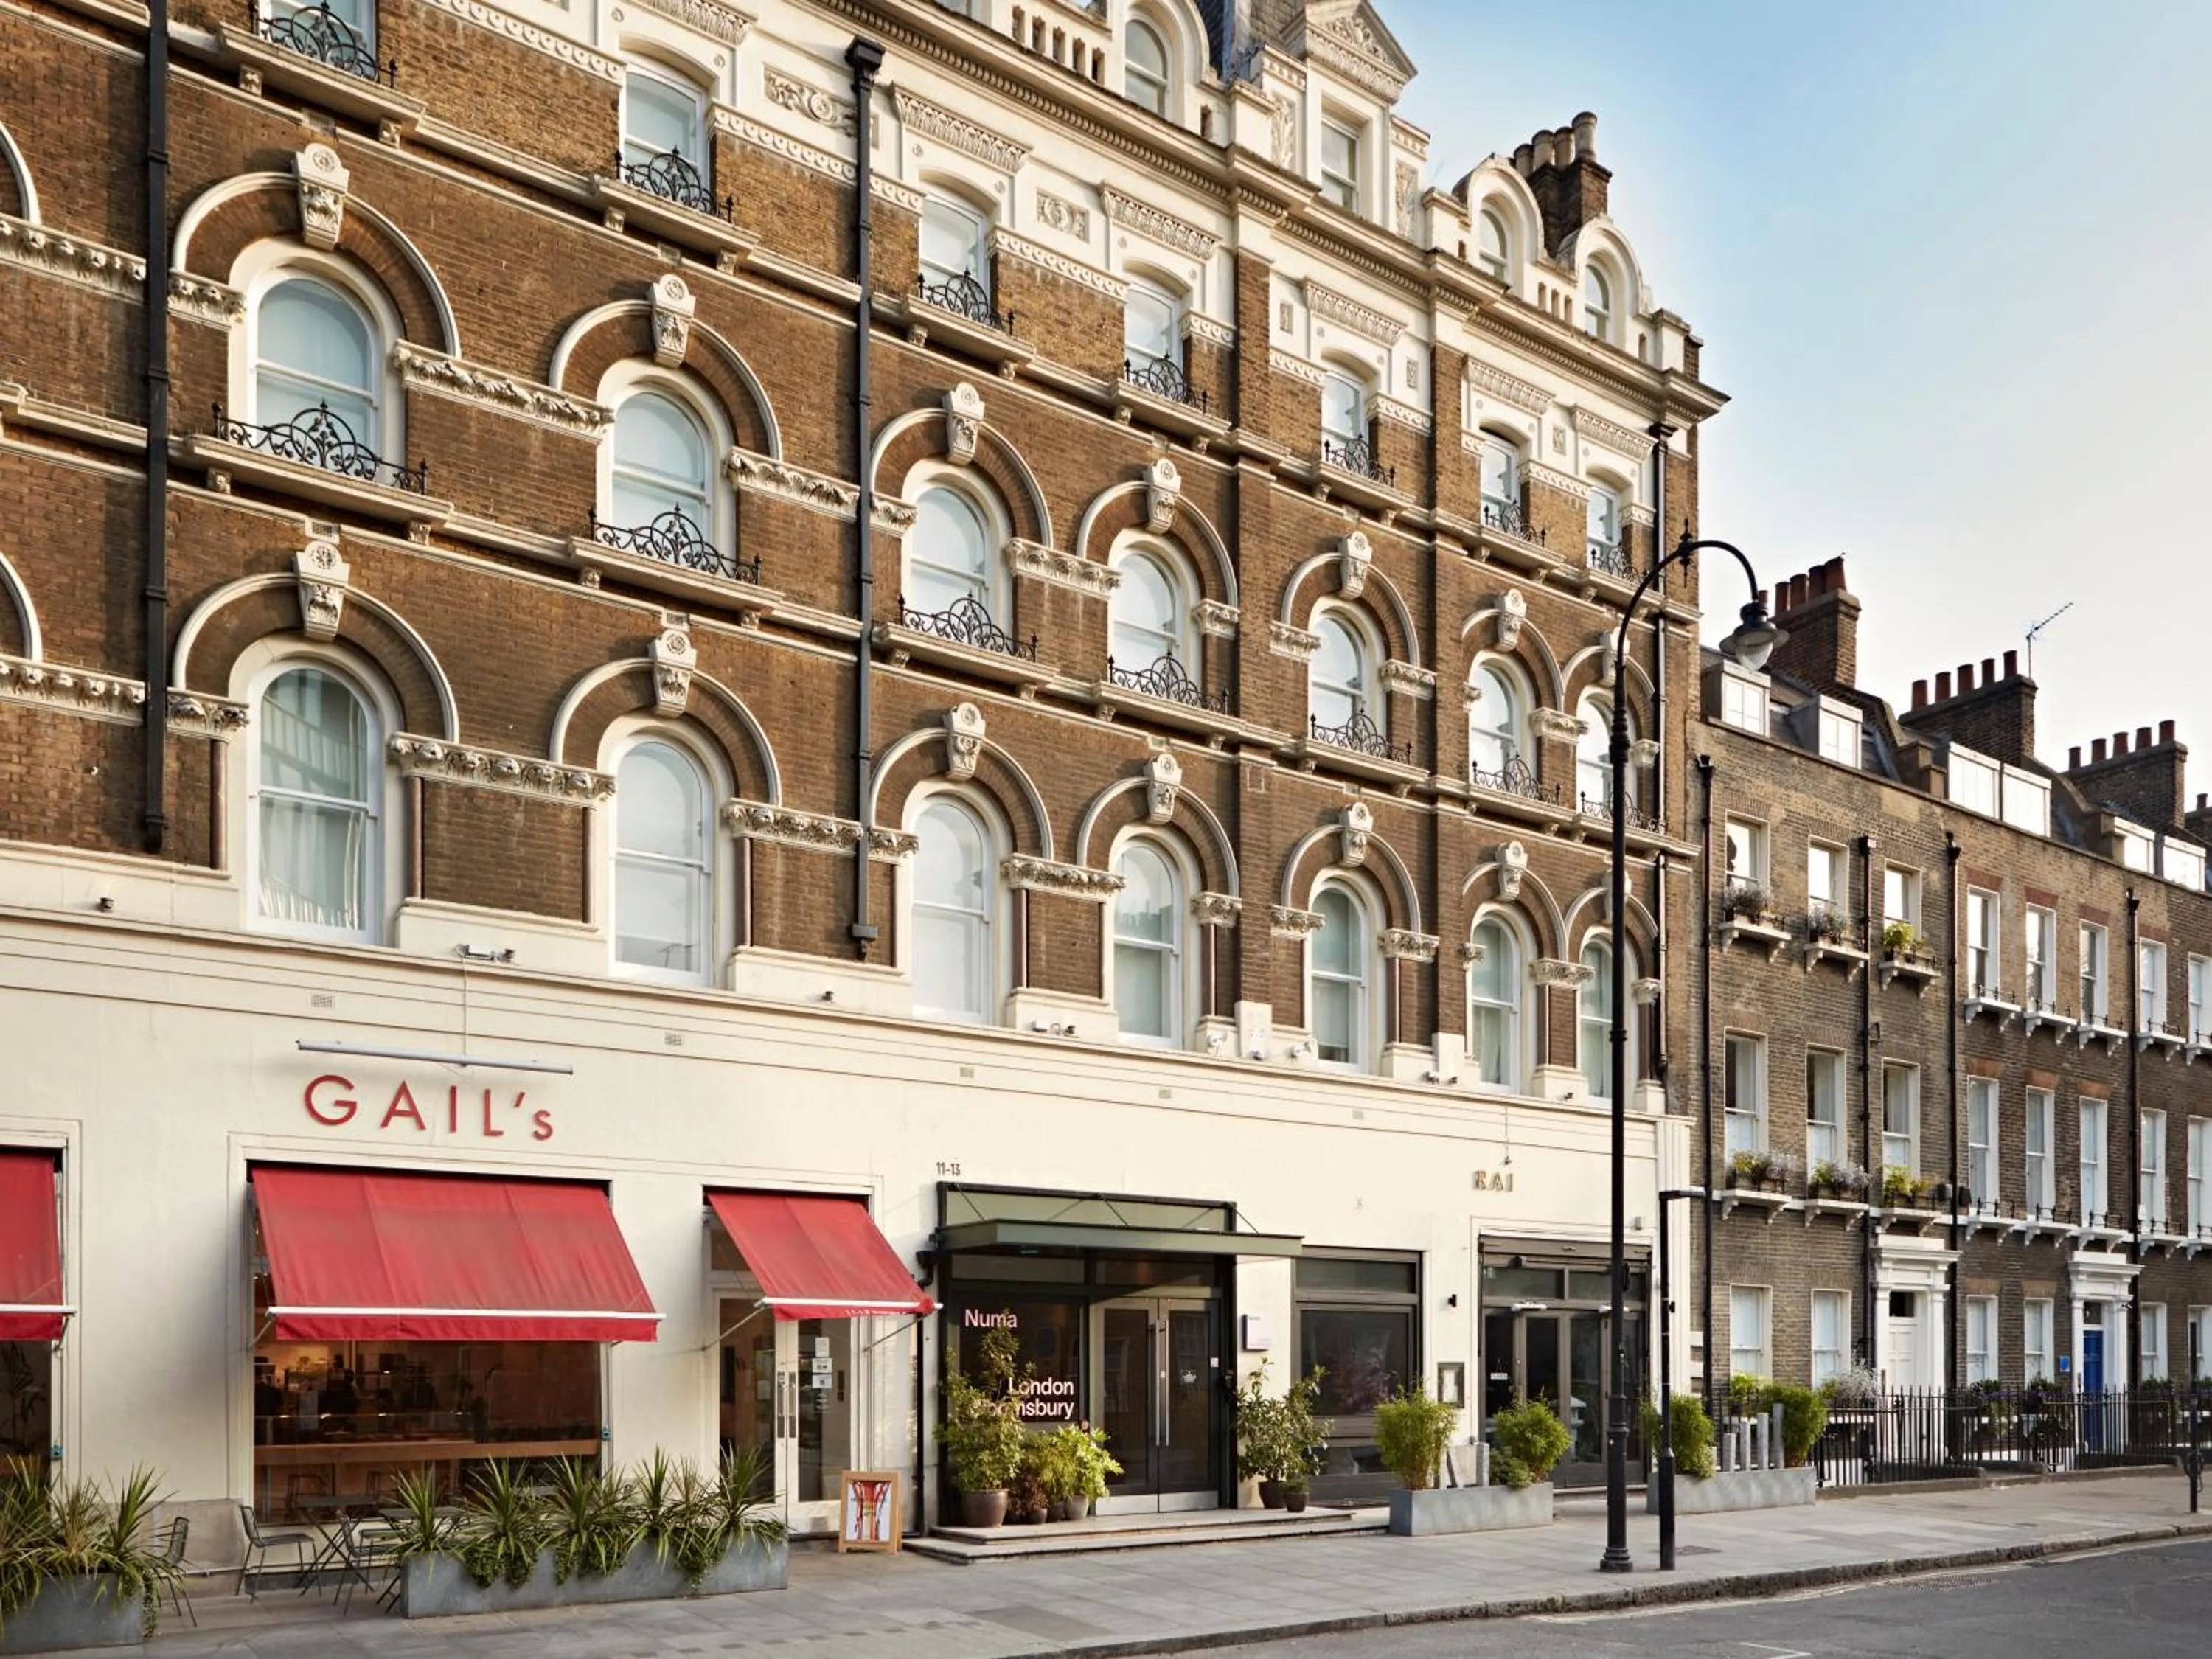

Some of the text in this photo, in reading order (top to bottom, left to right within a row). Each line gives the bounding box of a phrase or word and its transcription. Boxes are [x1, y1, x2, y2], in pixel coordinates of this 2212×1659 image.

[304, 1074, 553, 1141] GAIL's
[936, 1161, 961, 1176] 11-13
[1472, 1170, 1513, 1192] RAI
[964, 1309, 1018, 1328] Numa
[1009, 1377, 1074, 1395] London
